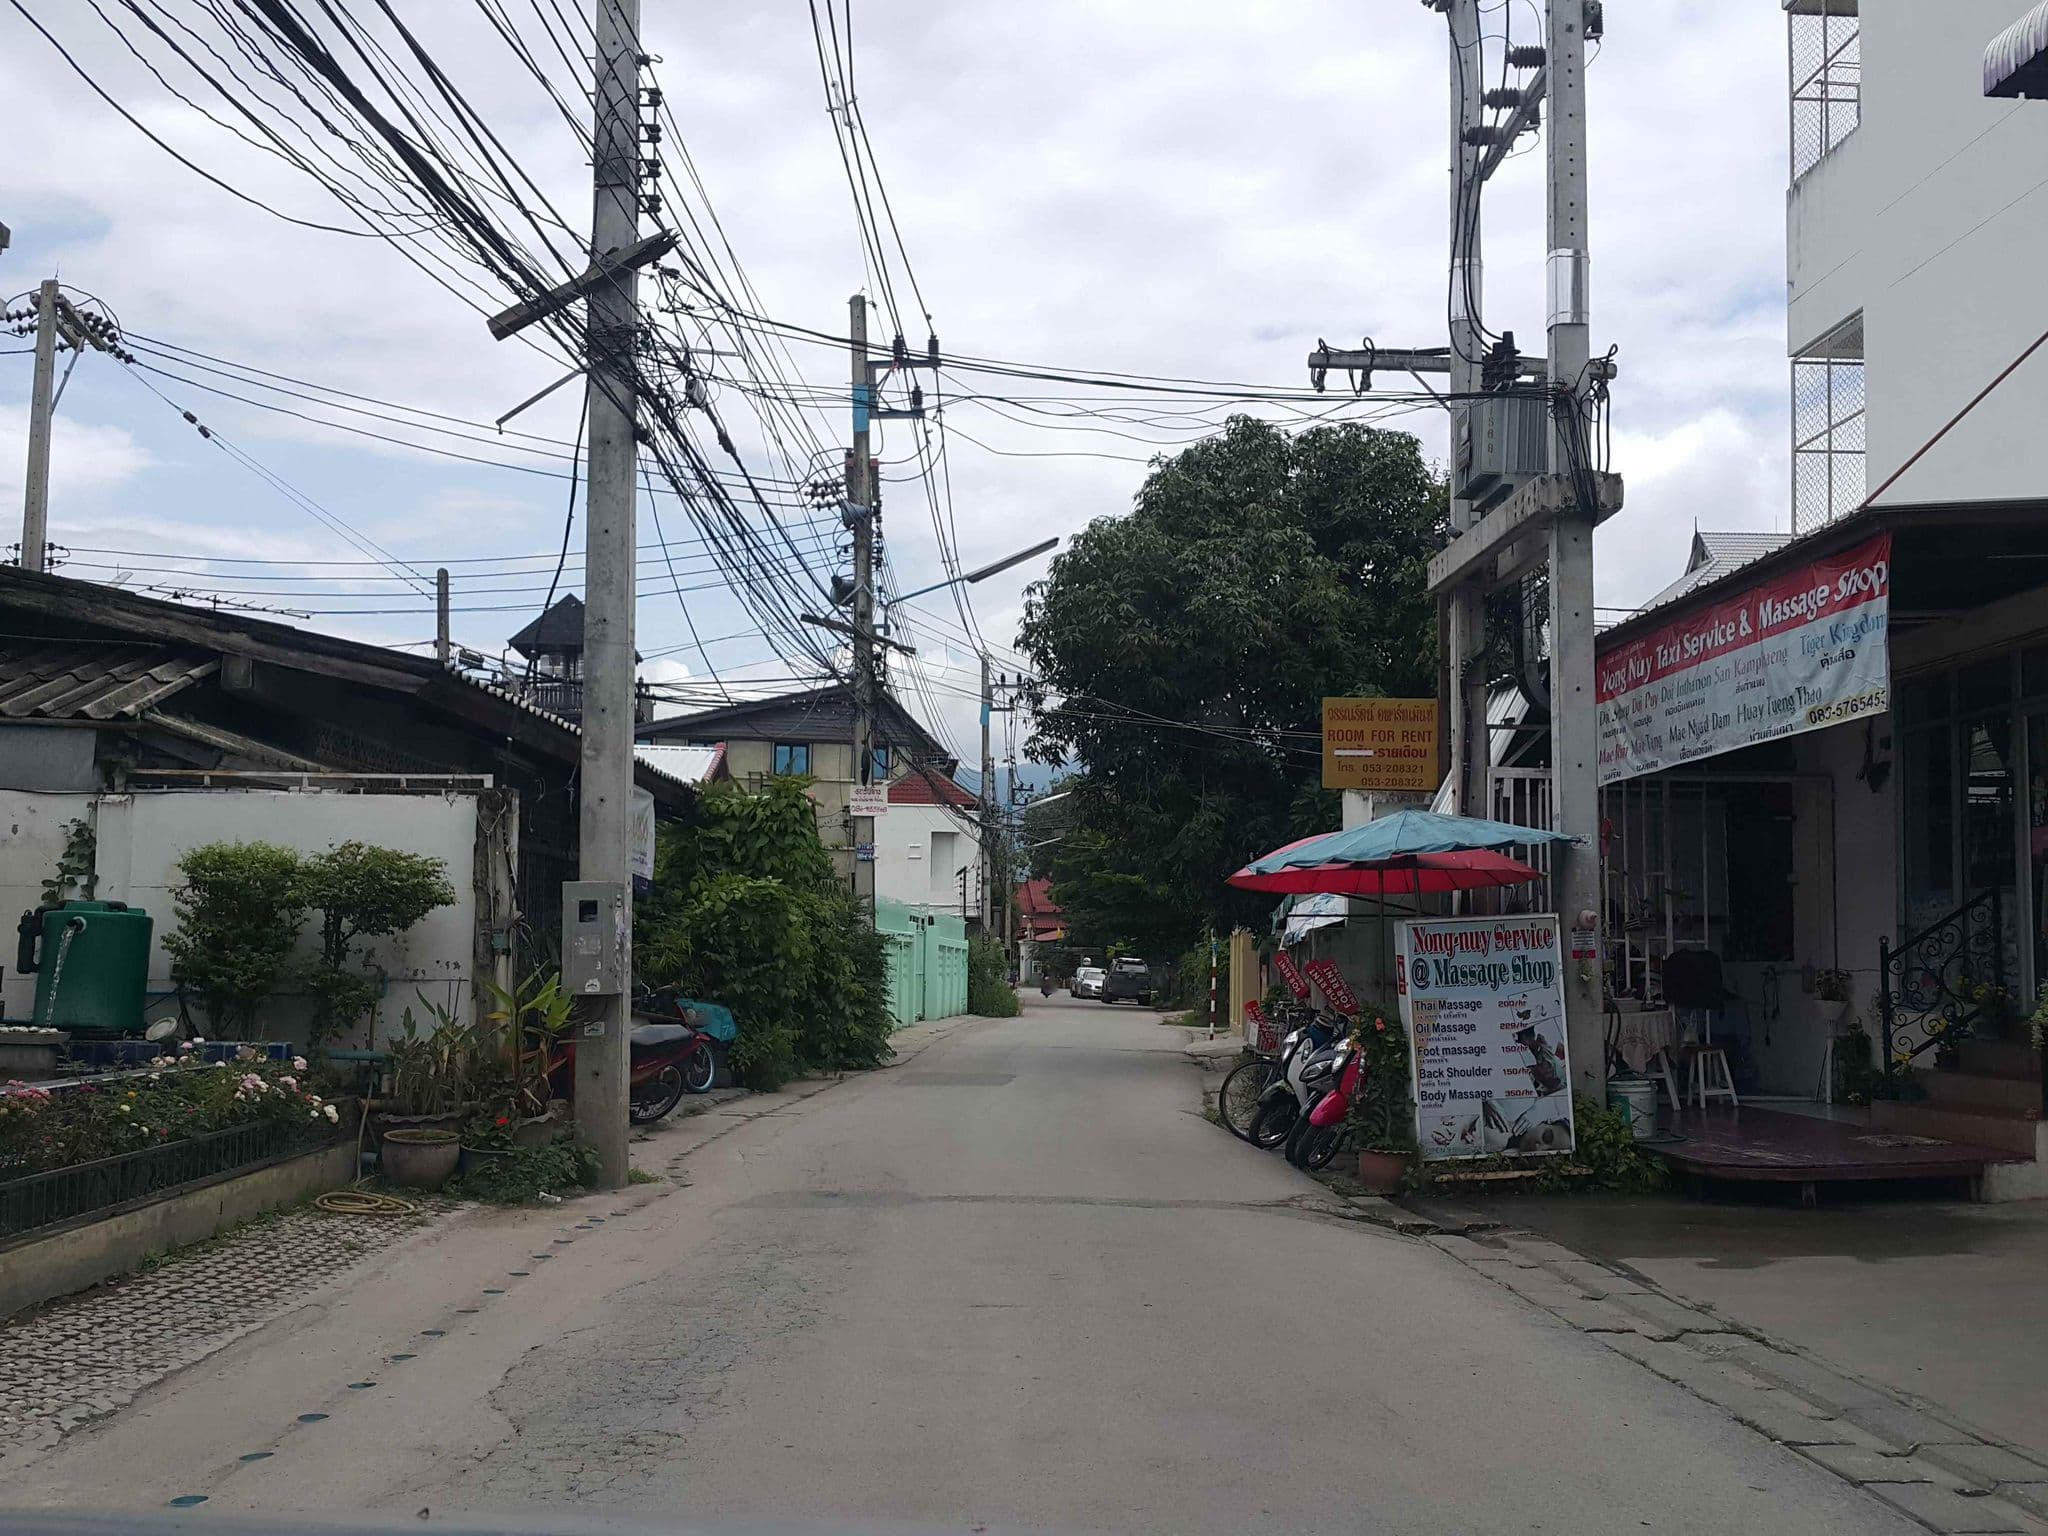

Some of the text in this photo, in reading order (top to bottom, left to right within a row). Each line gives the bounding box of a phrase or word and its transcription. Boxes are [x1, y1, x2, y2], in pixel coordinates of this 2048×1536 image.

[1629, 655, 1653, 683] Nuy
[1656, 637, 1680, 670] Taxi
[1683, 620, 1736, 659] Service
[1740, 608, 1753, 637] &
[1759, 584, 1831, 630] Massage
[1834, 561, 1887, 602] Shop
[1661, 684, 1674, 703] Doi
[1676, 674, 1712, 697] Inthanon
[1714, 665, 1731, 683] San
[1800, 634, 1826, 658] Tiger
[1828, 613, 1887, 645] Kingdom
[1669, 724, 1686, 744] Mae
[1711, 712, 1732, 730] Dam
[1737, 703, 1764, 723] Huay
[1767, 694, 1796, 716] Tueng
[1795, 686, 1822, 707] Thao
[1327, 729, 1433, 742] ROOM FOR RENT
[1494, 918, 1554, 951] Service
[1278, 960, 1292, 978] RENT
[1308, 968, 1328, 989] RENT
[1411, 957, 1430, 990] @
[1433, 958, 1509, 991] Massage
[1512, 955, 1555, 989] Shop
[1323, 966, 1352, 1009] FOR RENT
[1414, 1000, 1437, 1011] Thai
[1438, 1000, 1483, 1012] Massage
[1415, 1023, 1430, 1034] Oil
[1432, 1022, 1477, 1034] Massage
[1417, 1045, 1529, 1057] Foot massage 150/hr
[1420, 1066, 1531, 1079] Back Shoulder 150/hr
[1421, 1090, 1446, 1102] Body
[1448, 1088, 1494, 1101] Massage
